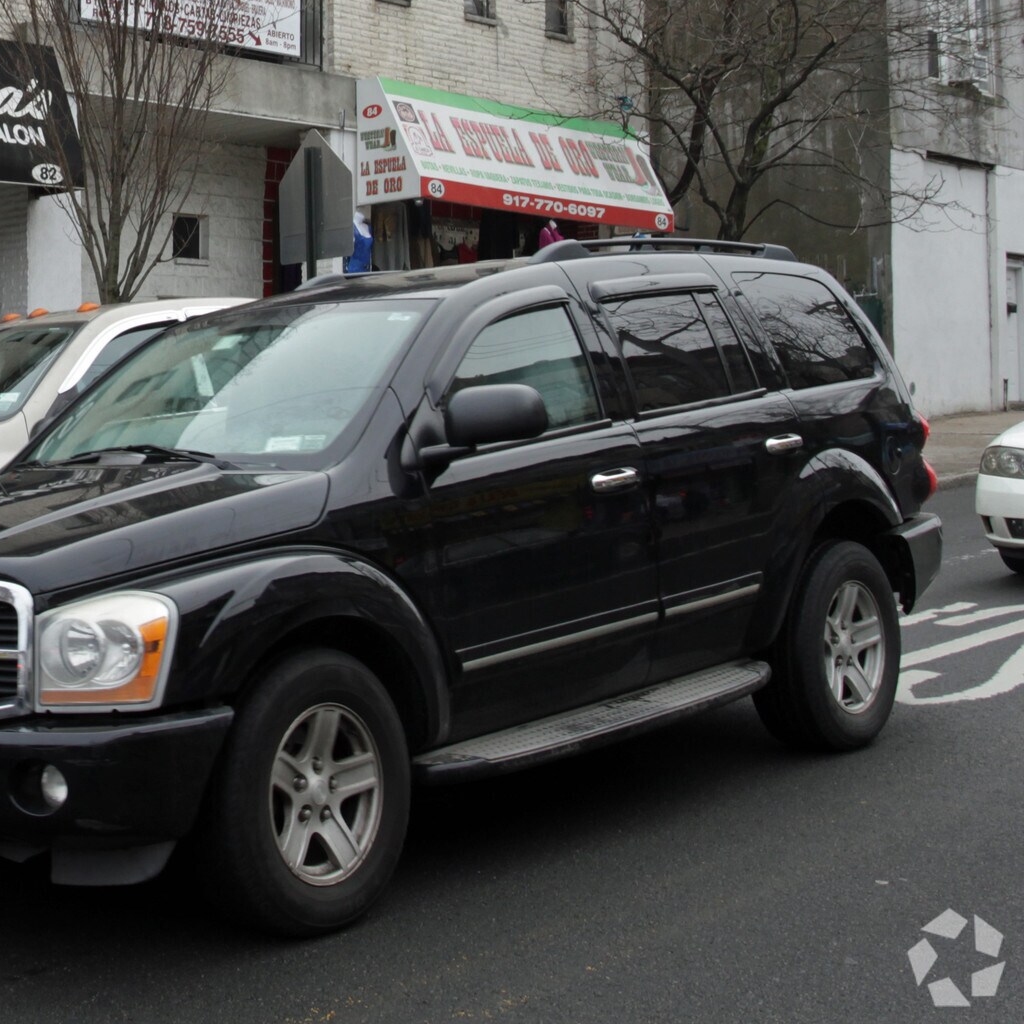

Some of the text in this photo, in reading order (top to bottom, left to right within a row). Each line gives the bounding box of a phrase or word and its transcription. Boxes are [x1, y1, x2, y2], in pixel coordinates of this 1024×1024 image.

[145, 11, 244, 44] 78-759-7555
[267, 29, 294, 41] ABIERTO
[265, 39, 278, 47] 8am
[283, 41, 297, 50] 8pm
[367, 107, 377, 116] 84
[417, 110, 456, 154] LA
[449, 116, 535, 168] ESPUELA
[528, 131, 564, 173] DE
[558, 136, 600, 178] ORO
[40, 166, 57, 181] 82
[360, 156, 407, 176] LA ESPUELA
[366, 176, 403, 196] DE ORO
[430, 182, 442, 194] 84
[502, 193, 606, 219] 917-770-6097
[657, 216, 666, 227] 84
